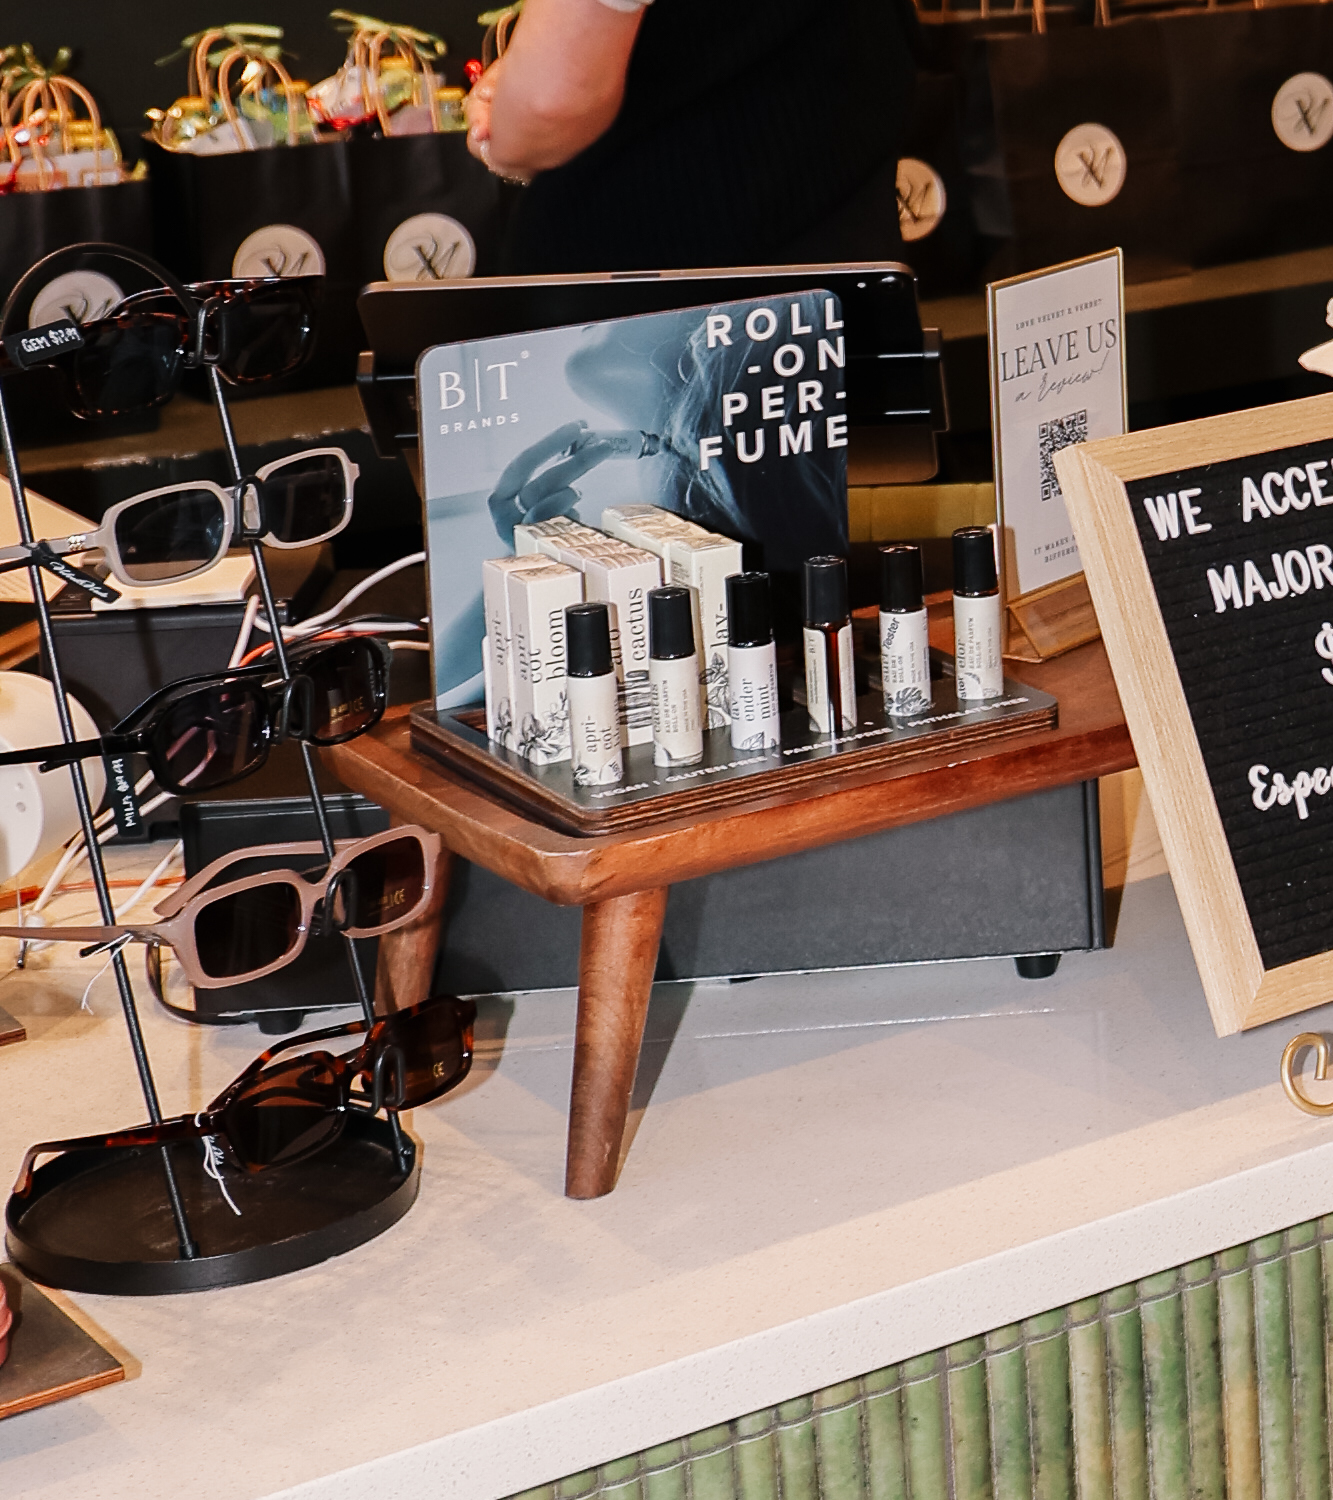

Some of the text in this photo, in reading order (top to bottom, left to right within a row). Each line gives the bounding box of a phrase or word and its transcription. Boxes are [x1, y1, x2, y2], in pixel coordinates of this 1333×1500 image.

[706, 298, 844, 348] ROLL
[1037, 309, 1064, 324] VELVET
[1000, 318, 1117, 382] LEAVE US
[439, 411, 521, 436] BRANDS
[723, 380, 847, 427] PER-
[699, 414, 848, 471] FUME
[1144, 487, 1213, 541] WE
[546, 608, 566, 682] bloom
[629, 587, 646, 662] cactus
[882, 617, 900, 650] Tester
[740, 678, 755, 722] ender
[756, 683, 771, 720] mint
[587, 715, 598, 753] apri-
[602, 725, 612, 751] cot
[591, 783, 649, 799] VEGAN
